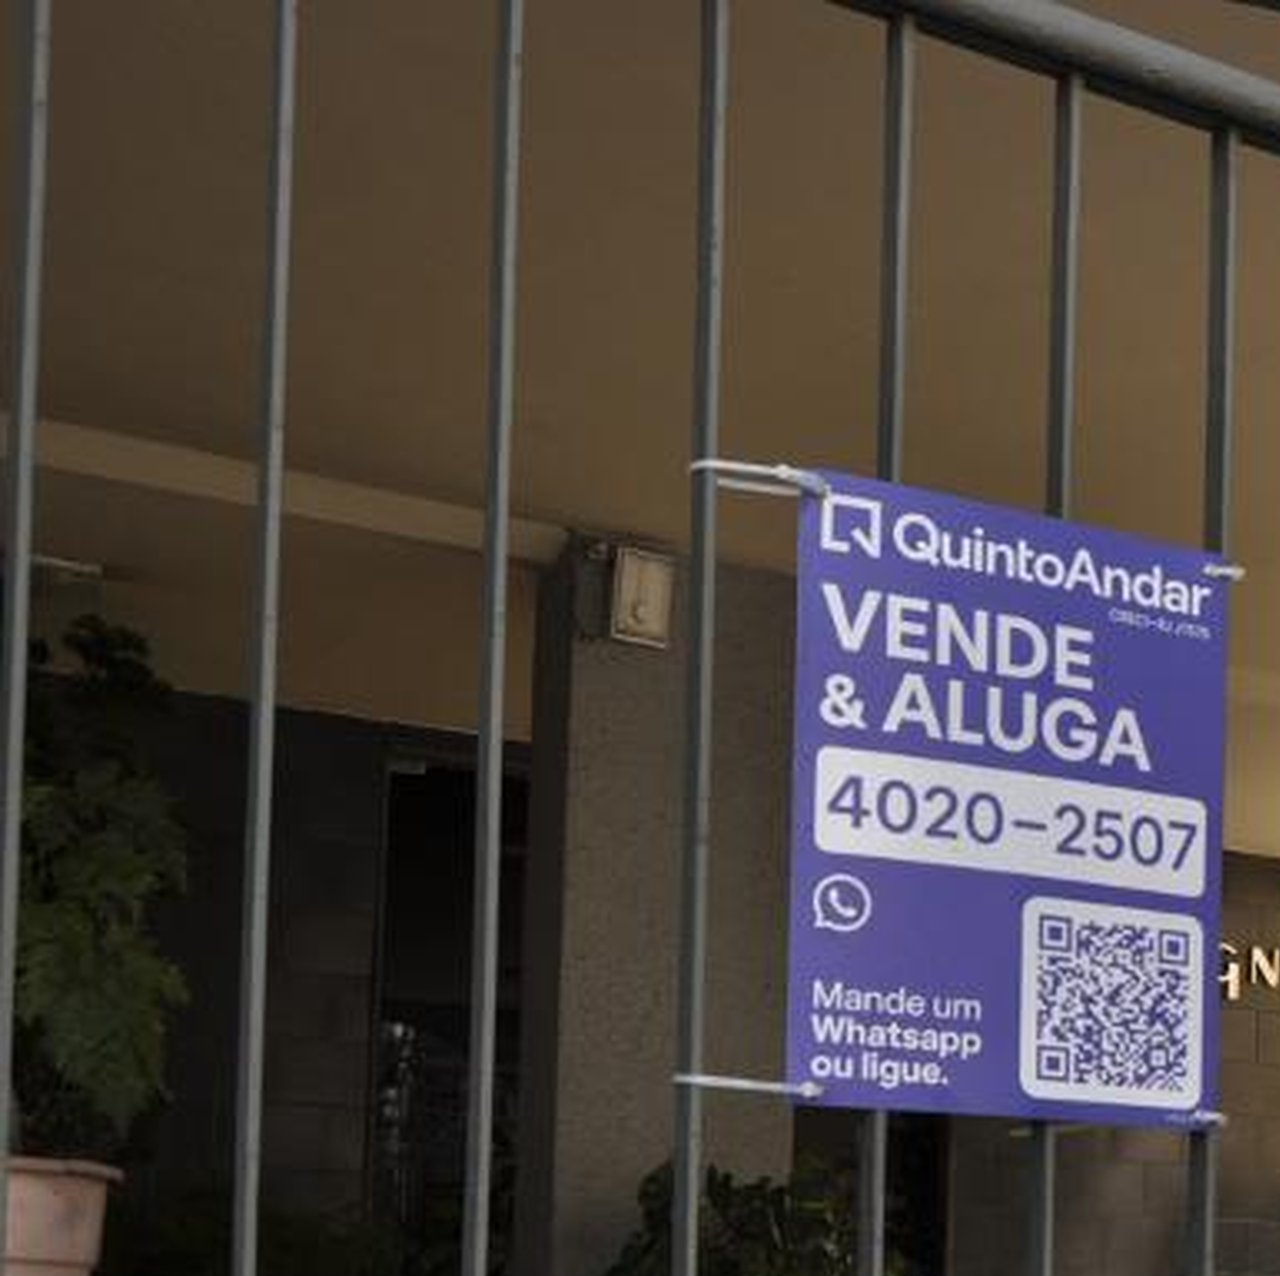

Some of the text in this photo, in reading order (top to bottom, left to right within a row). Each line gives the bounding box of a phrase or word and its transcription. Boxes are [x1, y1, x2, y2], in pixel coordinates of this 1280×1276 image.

[893, 513, 1212, 616] QuintoAndar
[823, 583, 1094, 691] VENDE
[819, 673, 1152, 772] & ALUGA
[828, 775, 1198, 872] 4020-2507
[811, 1013, 981, 1060] Whatsapp
[813, 979, 981, 1021] Mande um
[810, 1051, 948, 1089] ou ligue.
